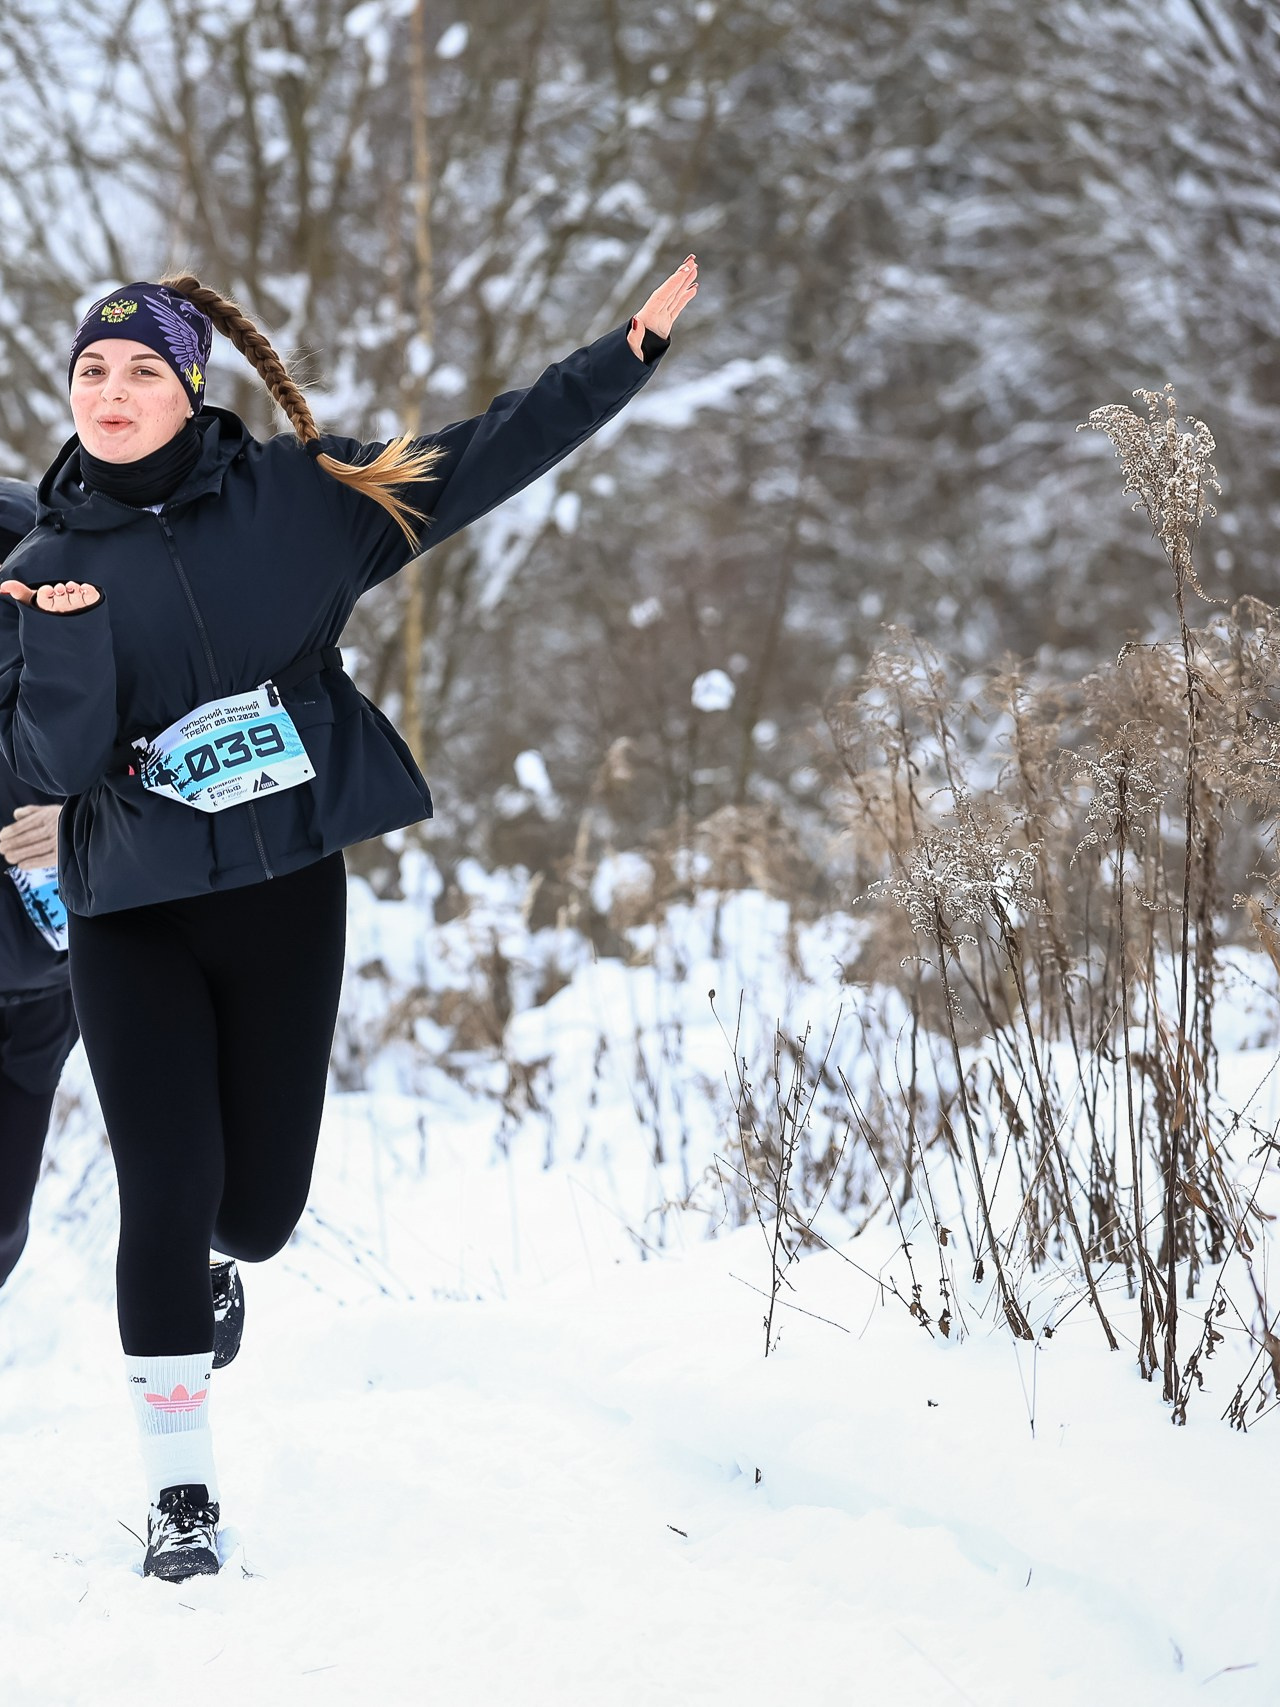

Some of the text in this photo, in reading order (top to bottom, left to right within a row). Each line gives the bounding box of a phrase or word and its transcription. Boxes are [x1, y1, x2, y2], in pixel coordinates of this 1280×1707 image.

[179, 701, 260, 734] ТУЛЬСКИЙ ЗИМНИЙ
[184, 724, 213, 740] ТРЕЙЛ
[184, 723, 286, 782] 039
